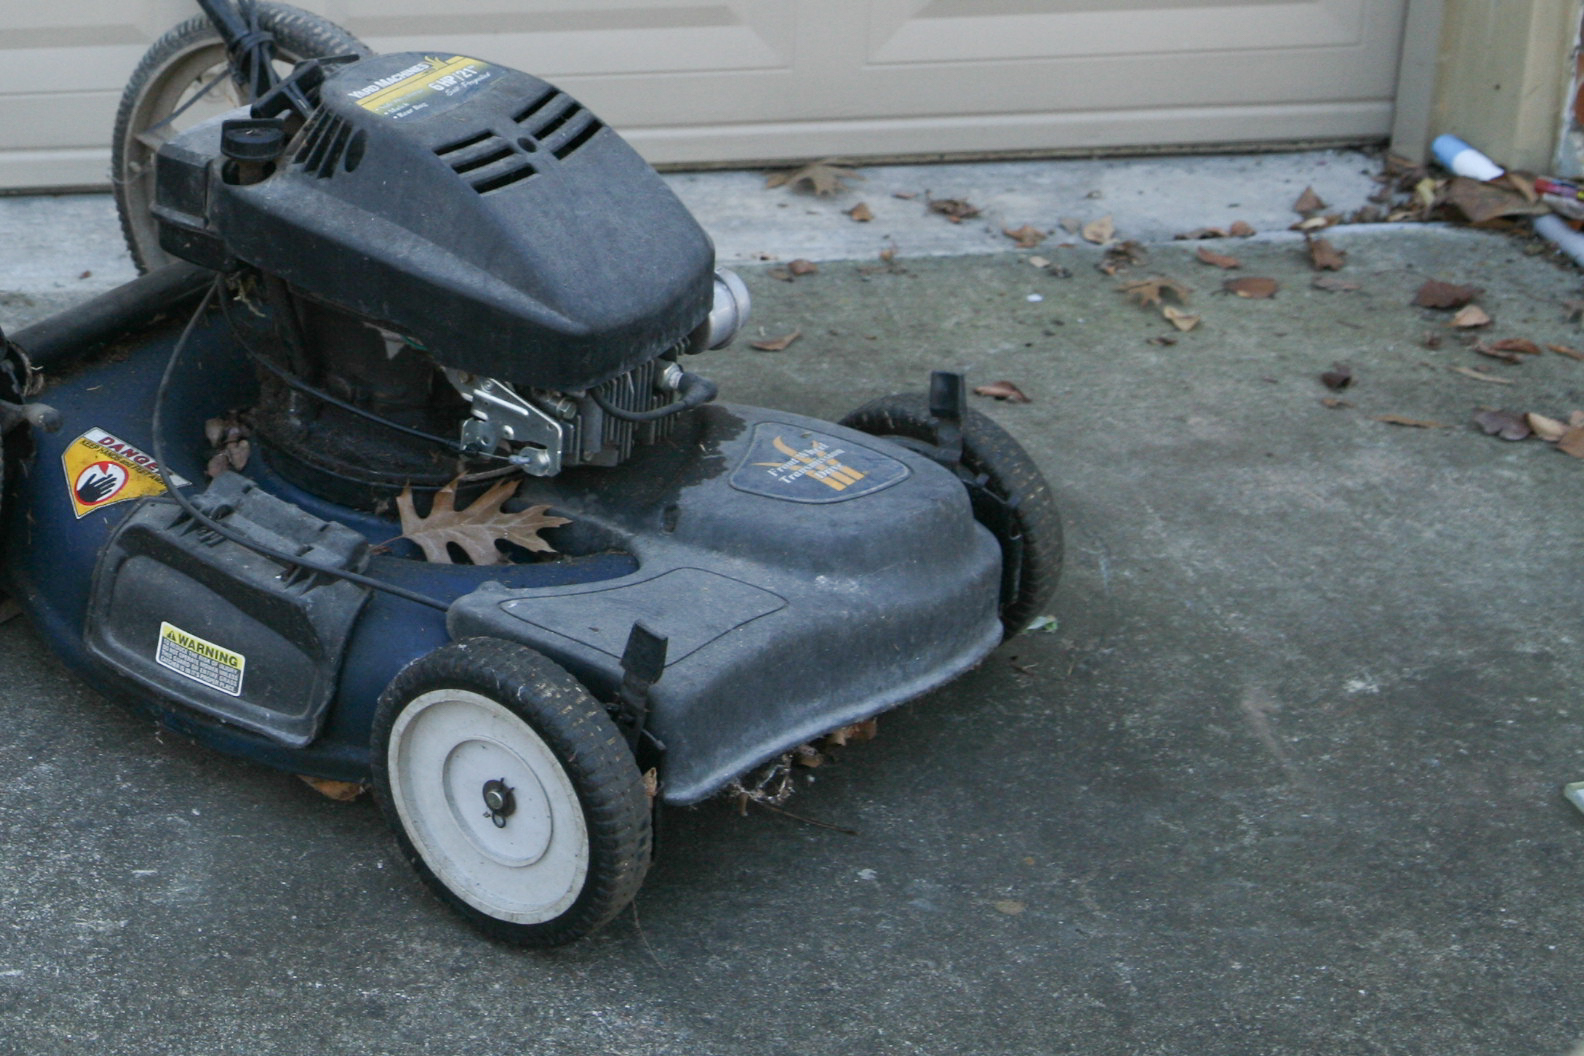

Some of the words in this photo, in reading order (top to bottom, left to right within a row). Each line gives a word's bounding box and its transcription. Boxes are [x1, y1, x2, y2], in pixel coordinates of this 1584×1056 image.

[348, 85, 380, 99] YARD
[767, 458, 800, 477] Front
[778, 448, 846, 483] Transmission
[178, 633, 238, 667] WARNING
